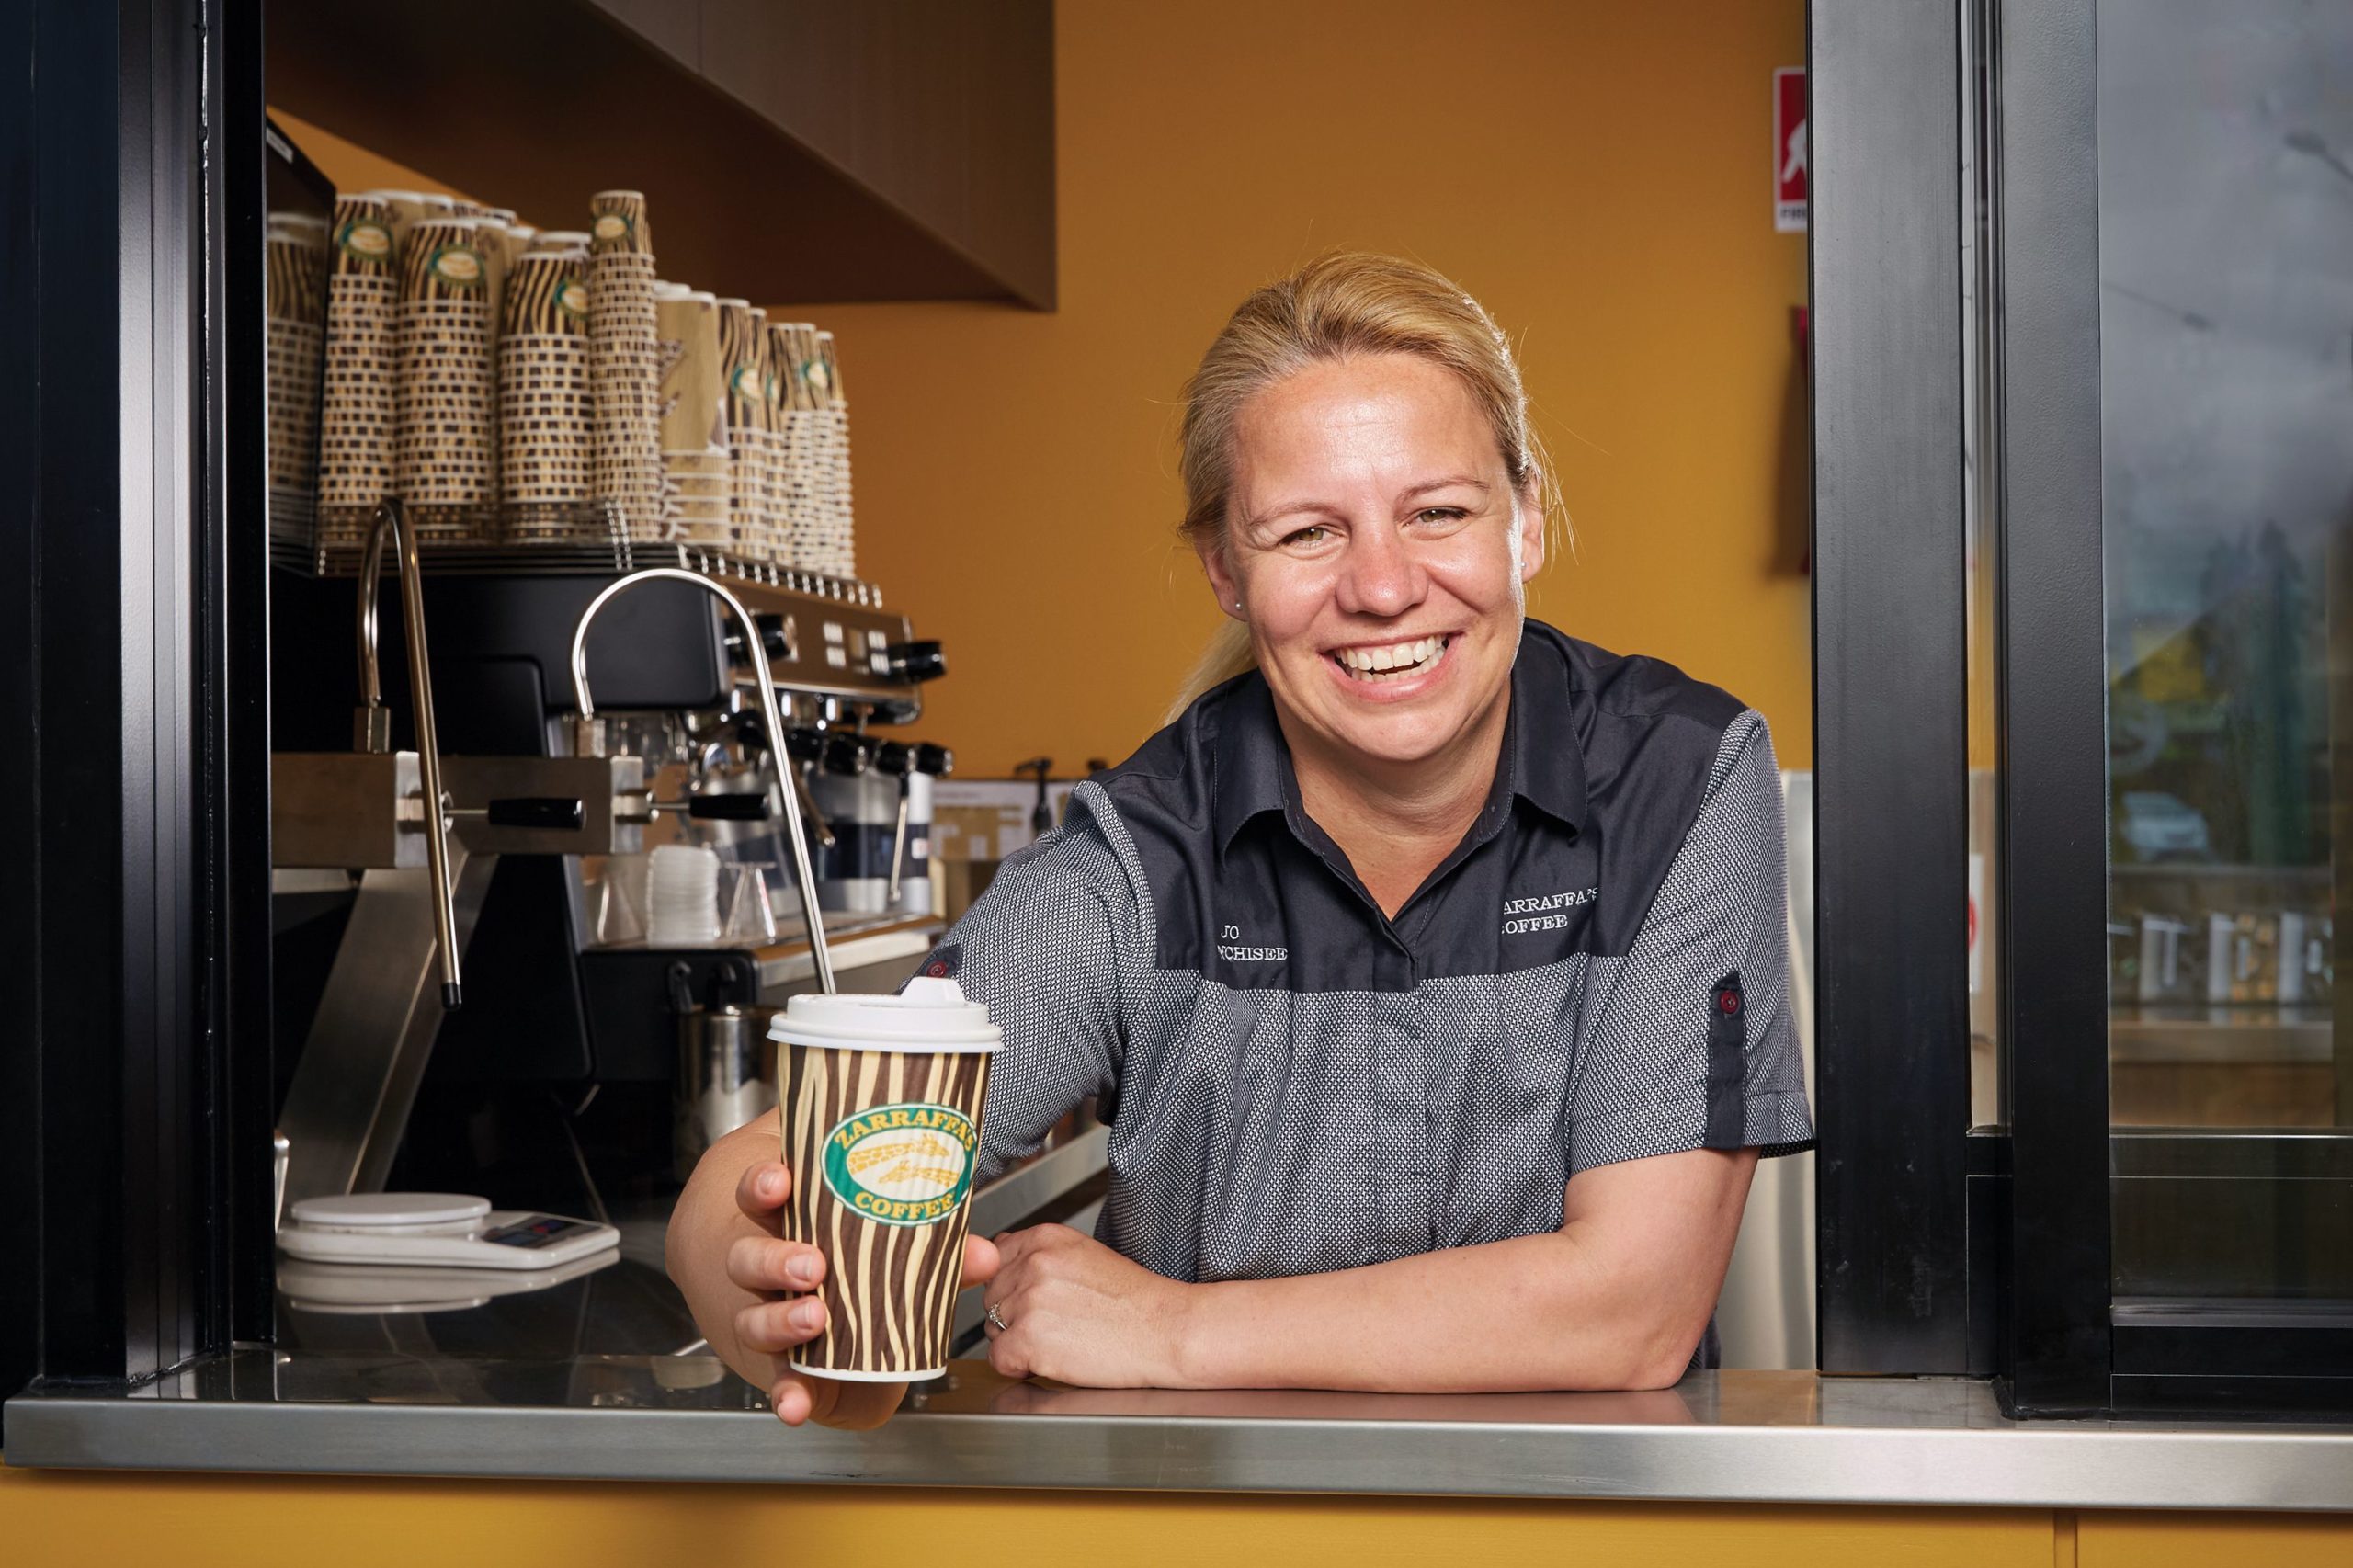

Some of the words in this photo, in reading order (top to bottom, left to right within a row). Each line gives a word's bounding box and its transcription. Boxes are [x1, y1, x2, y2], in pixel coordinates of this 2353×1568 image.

[1221, 925, 1239, 940] JO
[1501, 914, 1568, 934] OFFEE
[834, 1109, 974, 1151] ZARRAFFA'S
[855, 1191, 955, 1220] COFFEE
